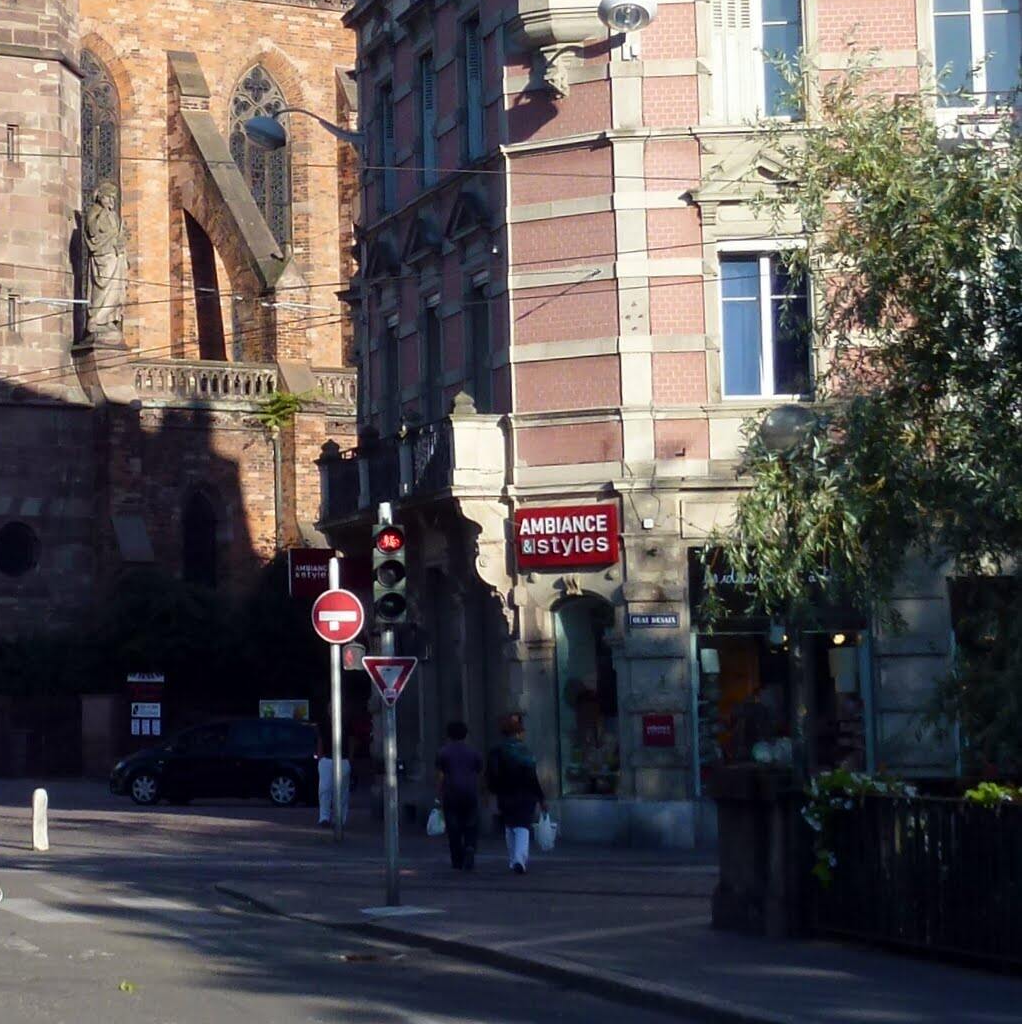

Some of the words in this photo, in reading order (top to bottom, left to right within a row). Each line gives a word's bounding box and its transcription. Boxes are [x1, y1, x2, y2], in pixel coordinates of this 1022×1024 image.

[519, 514, 608, 535] AMBIANCE
[295, 564, 327, 572] AMBIANC
[632, 616, 649, 624] QUAI
